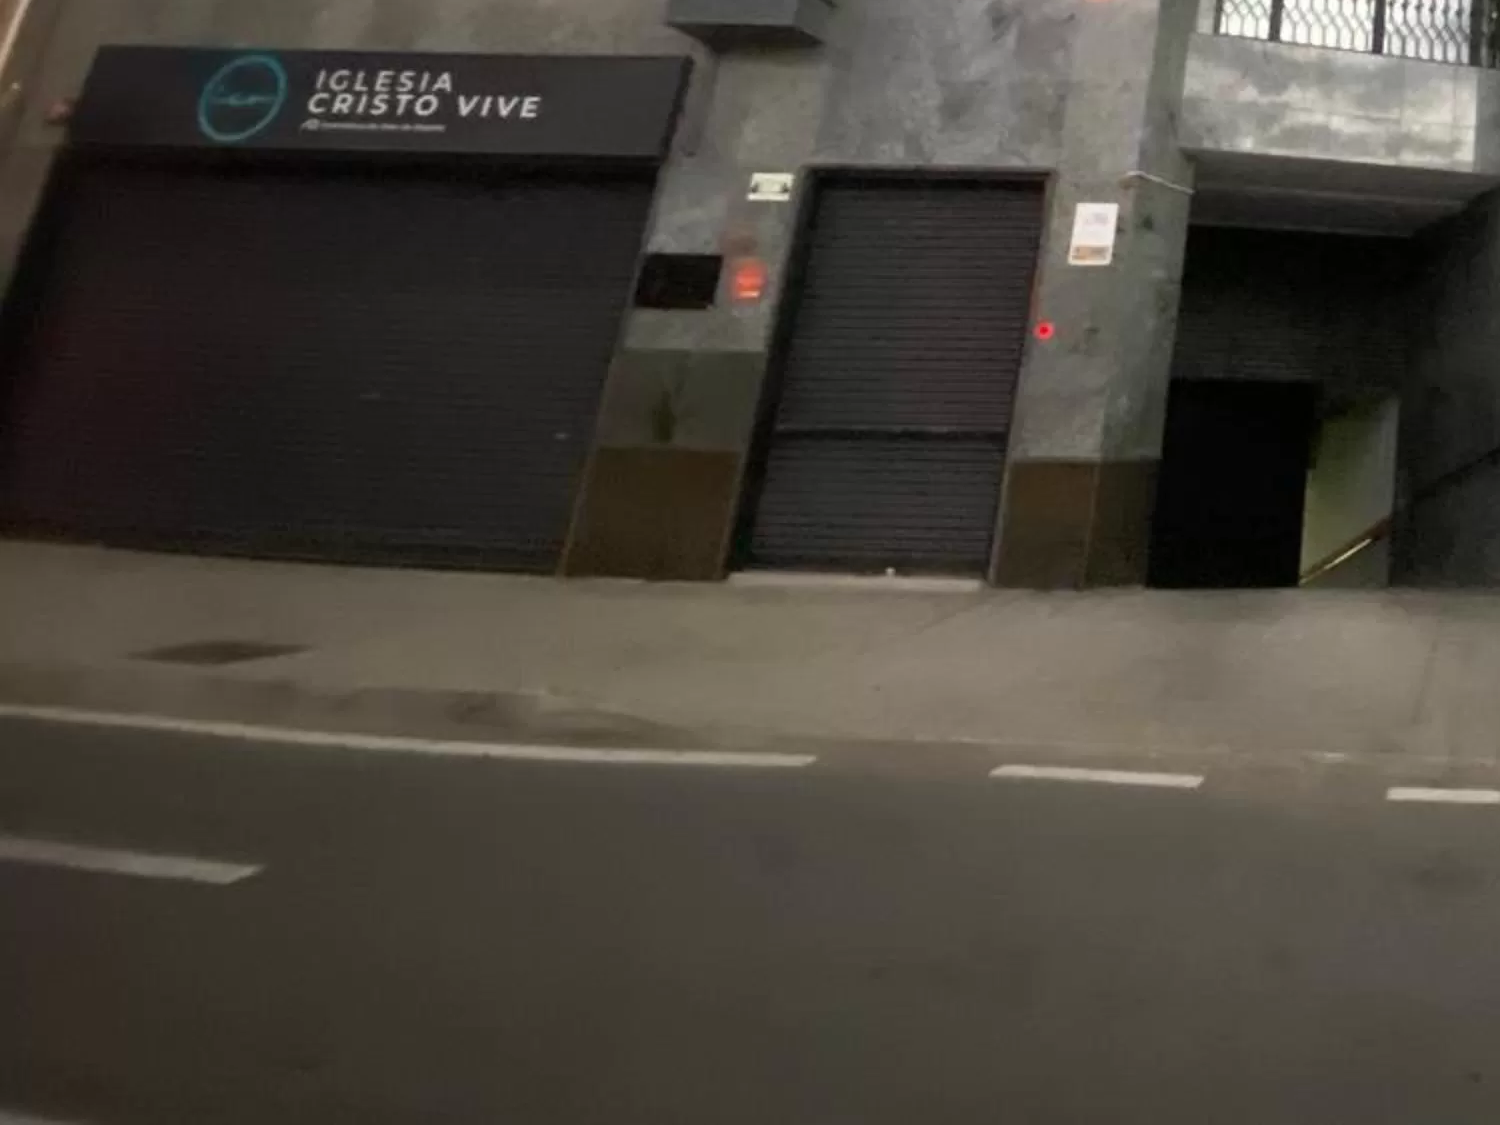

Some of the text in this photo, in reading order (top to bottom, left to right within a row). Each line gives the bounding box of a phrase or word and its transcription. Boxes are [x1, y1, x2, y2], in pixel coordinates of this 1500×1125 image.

[314, 69, 453, 93] IGLESIA
[307, 92, 541, 119] CRISTO VIVE
